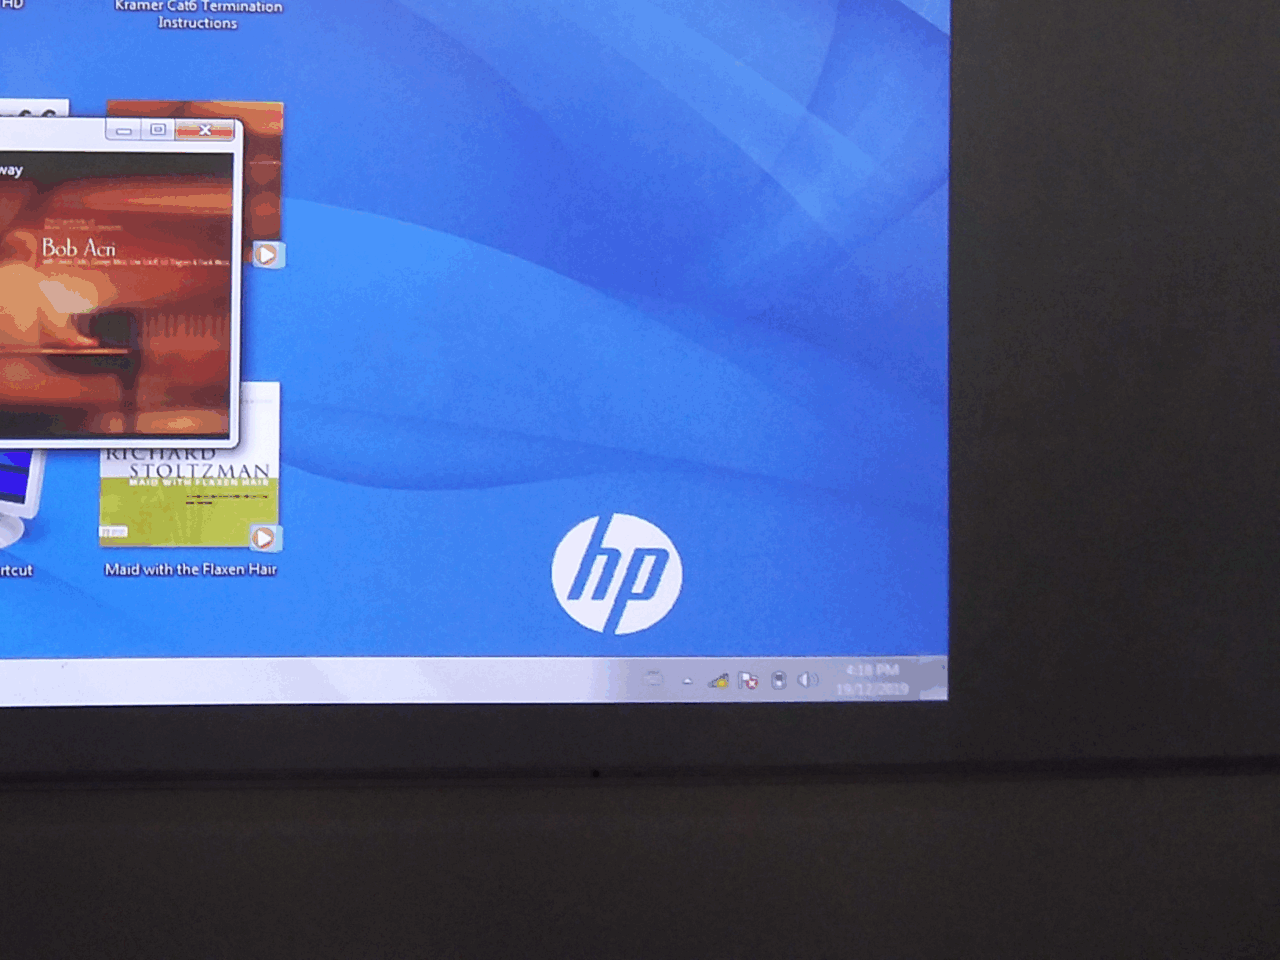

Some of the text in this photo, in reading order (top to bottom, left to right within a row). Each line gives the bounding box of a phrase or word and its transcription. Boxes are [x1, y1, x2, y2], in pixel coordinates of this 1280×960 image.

[167, 0, 198, 11] Cat6
[201, 0, 283, 13] Termination
[158, 16, 238, 29] Instructions
[42, 237, 78, 257] Bob
[107, 448, 216, 460] RICHARD
[130, 464, 269, 479] STOLTZMAN
[105, 563, 277, 576] Maid with the Flaxen Hair
[876, 663, 900, 676] PM
